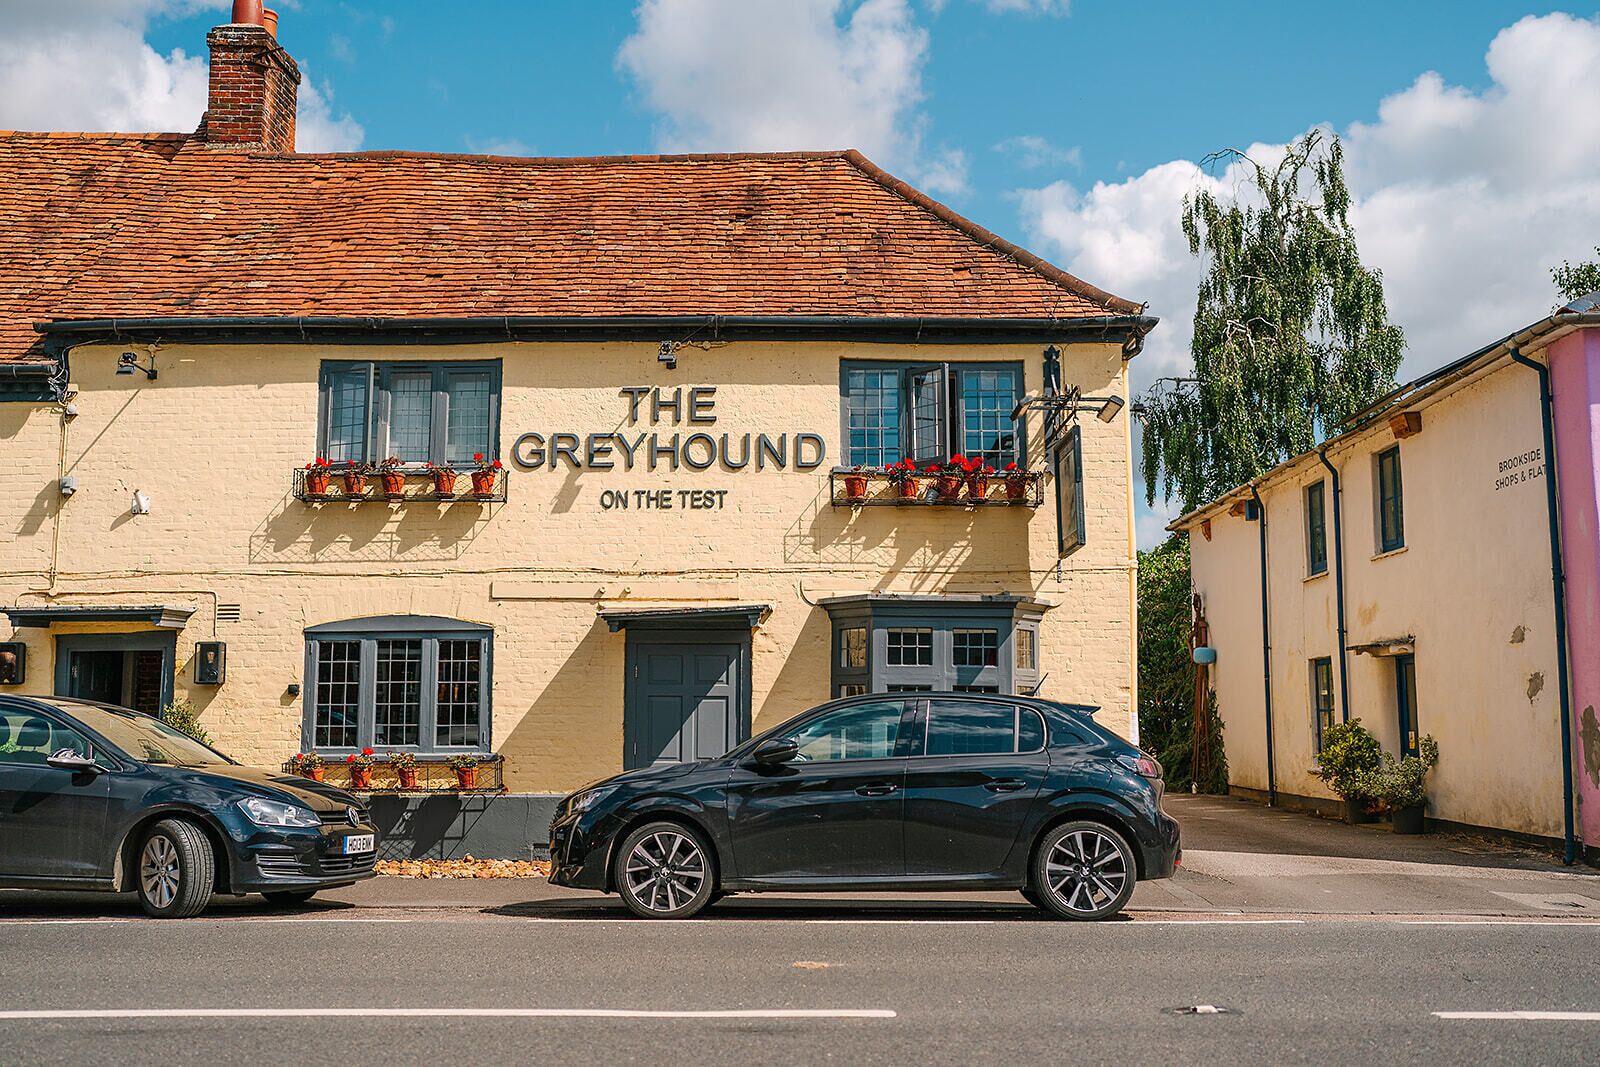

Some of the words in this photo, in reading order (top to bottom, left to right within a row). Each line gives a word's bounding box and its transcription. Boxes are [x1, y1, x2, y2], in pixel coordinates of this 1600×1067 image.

[621, 387, 718, 423] THE
[513, 432, 827, 470] GREYHOUND
[1498, 448, 1542, 473] BROOKSIDE
[1495, 473, 1519, 491] SHOPS
[1520, 470, 1527, 482] &
[1528, 463, 1547, 480] FLAT
[601, 489, 630, 510] ON
[634, 489, 673, 510] THE
[677, 489, 728, 510] TEST
